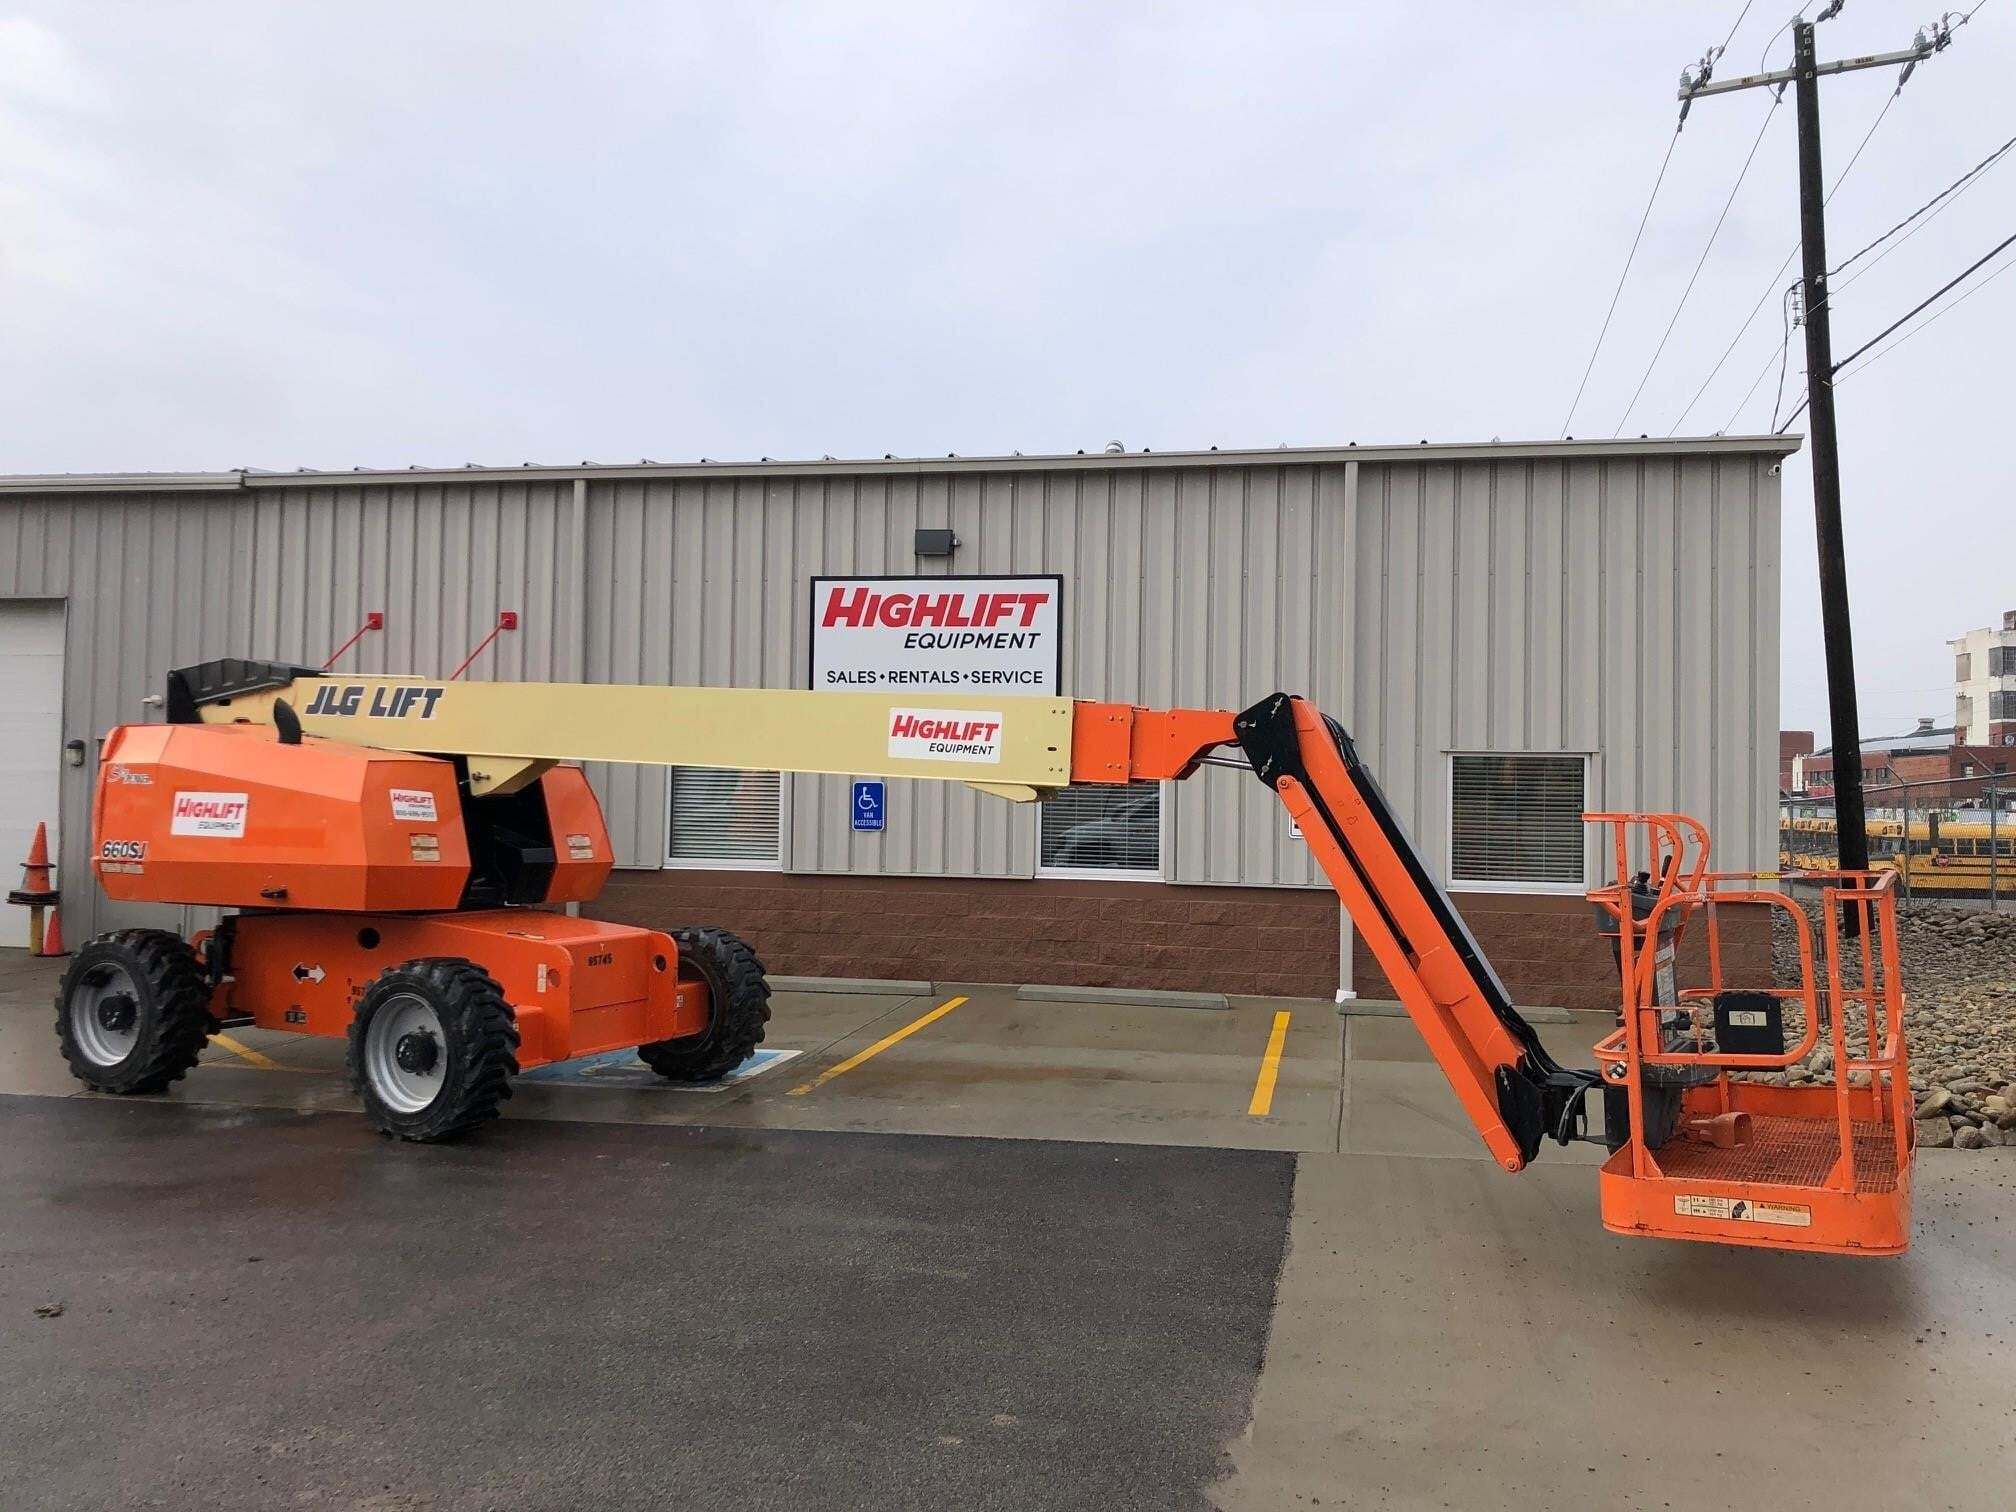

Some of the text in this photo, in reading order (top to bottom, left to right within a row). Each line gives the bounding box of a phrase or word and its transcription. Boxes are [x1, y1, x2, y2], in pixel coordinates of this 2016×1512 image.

[822, 587, 1050, 628] HIGHLIFT
[904, 632, 1042, 650] EQUIPMENT
[826, 670, 1043, 684] SALES RENTALS SERVICE
[304, 685, 445, 719] JLG LIFT
[891, 714, 1000, 742] HIGHLIFT
[929, 742, 995, 756] EQUIPMENT
[176, 798, 245, 819] HIGHLIFT
[863, 811, 874, 819] VAN
[854, 819, 882, 827] ACCESSIBLE
[102, 840, 147, 860] 660SJ
[1766, 1203, 1801, 1212] WARNING
